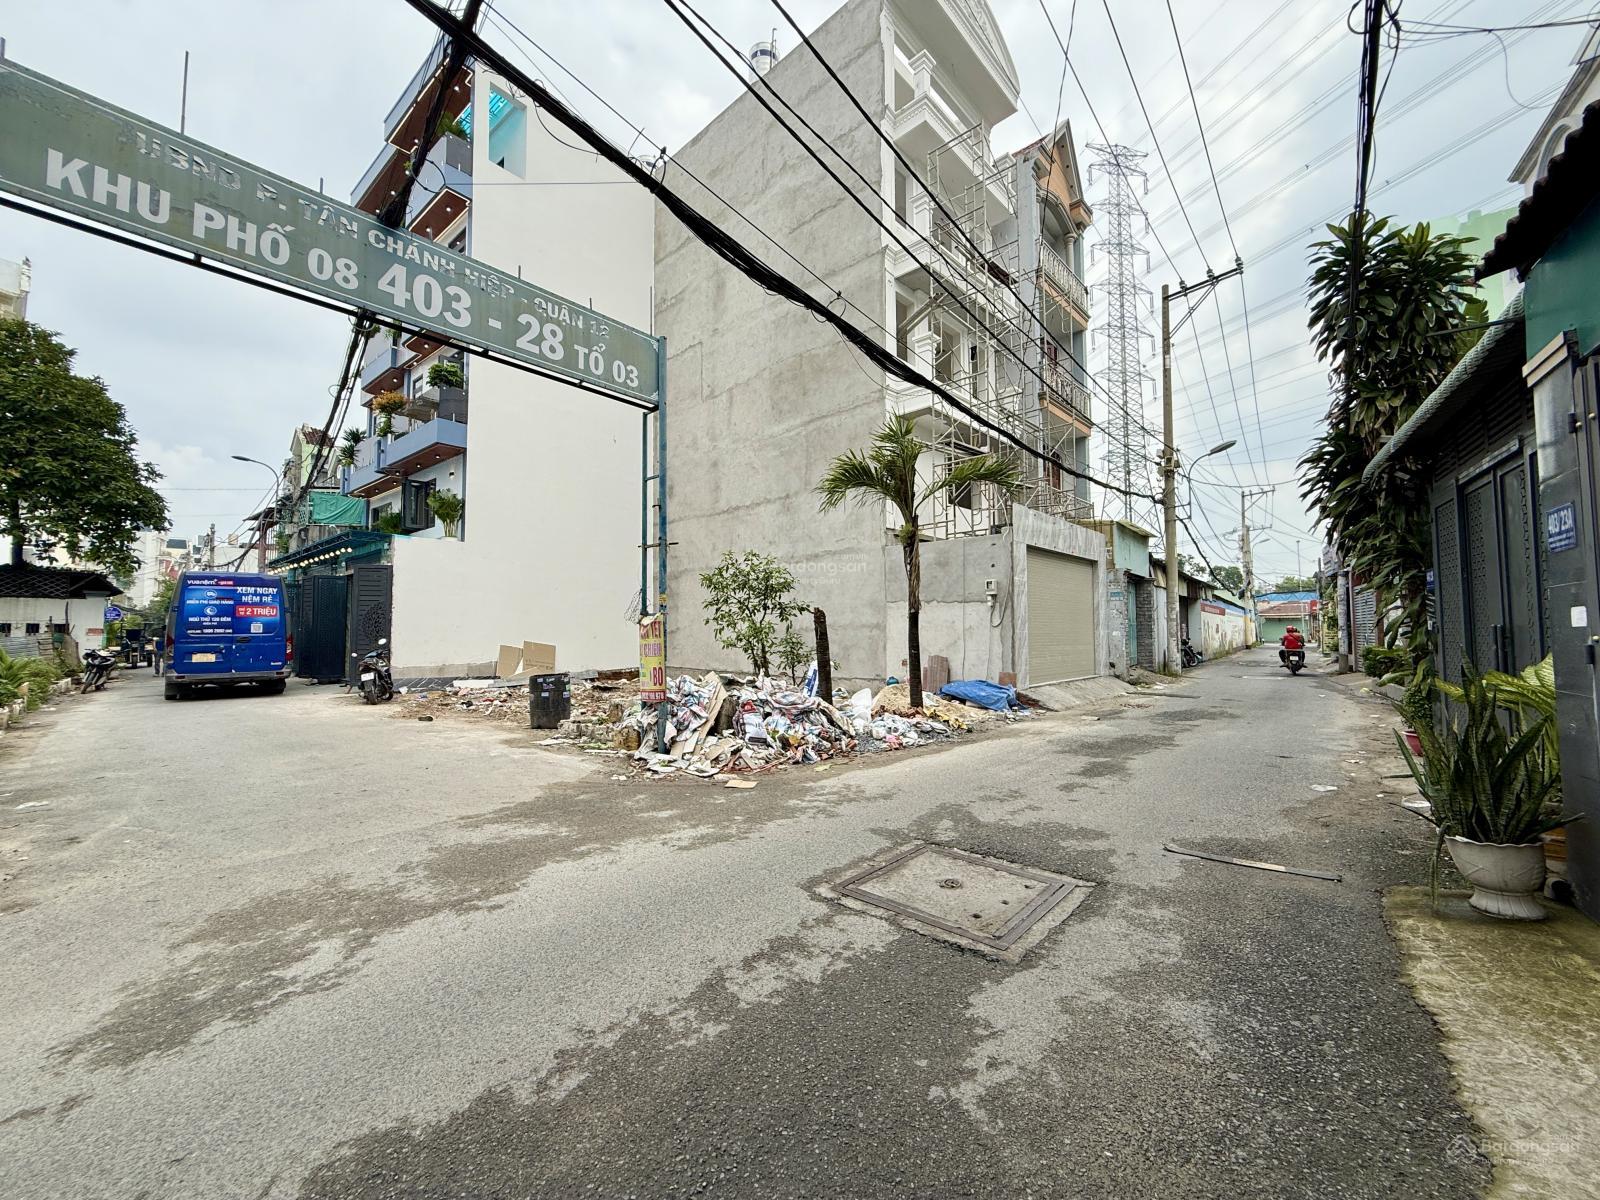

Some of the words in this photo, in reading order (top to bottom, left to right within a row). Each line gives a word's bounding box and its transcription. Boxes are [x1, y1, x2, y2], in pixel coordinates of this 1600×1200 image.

[46, 147, 171, 224] KHU
[192, 201, 295, 266] PHỐ
[307, 246, 359, 291] 08
[377, 263, 472, 328] 403
[515, 313, 566, 362] 28
[573, 342, 606, 377] TỔ
[612, 360, 640, 389] 03
[298, 197, 358, 240] TÂN
[368, 229, 456, 279] CHÁNH
[464, 266, 515, 301] HIỆP
[533, 297, 584, 330] QUẬN
[242, 594, 260, 604] NỆM
[246, 607, 252, 615] 2
[252, 607, 277, 617] TRIỆU
